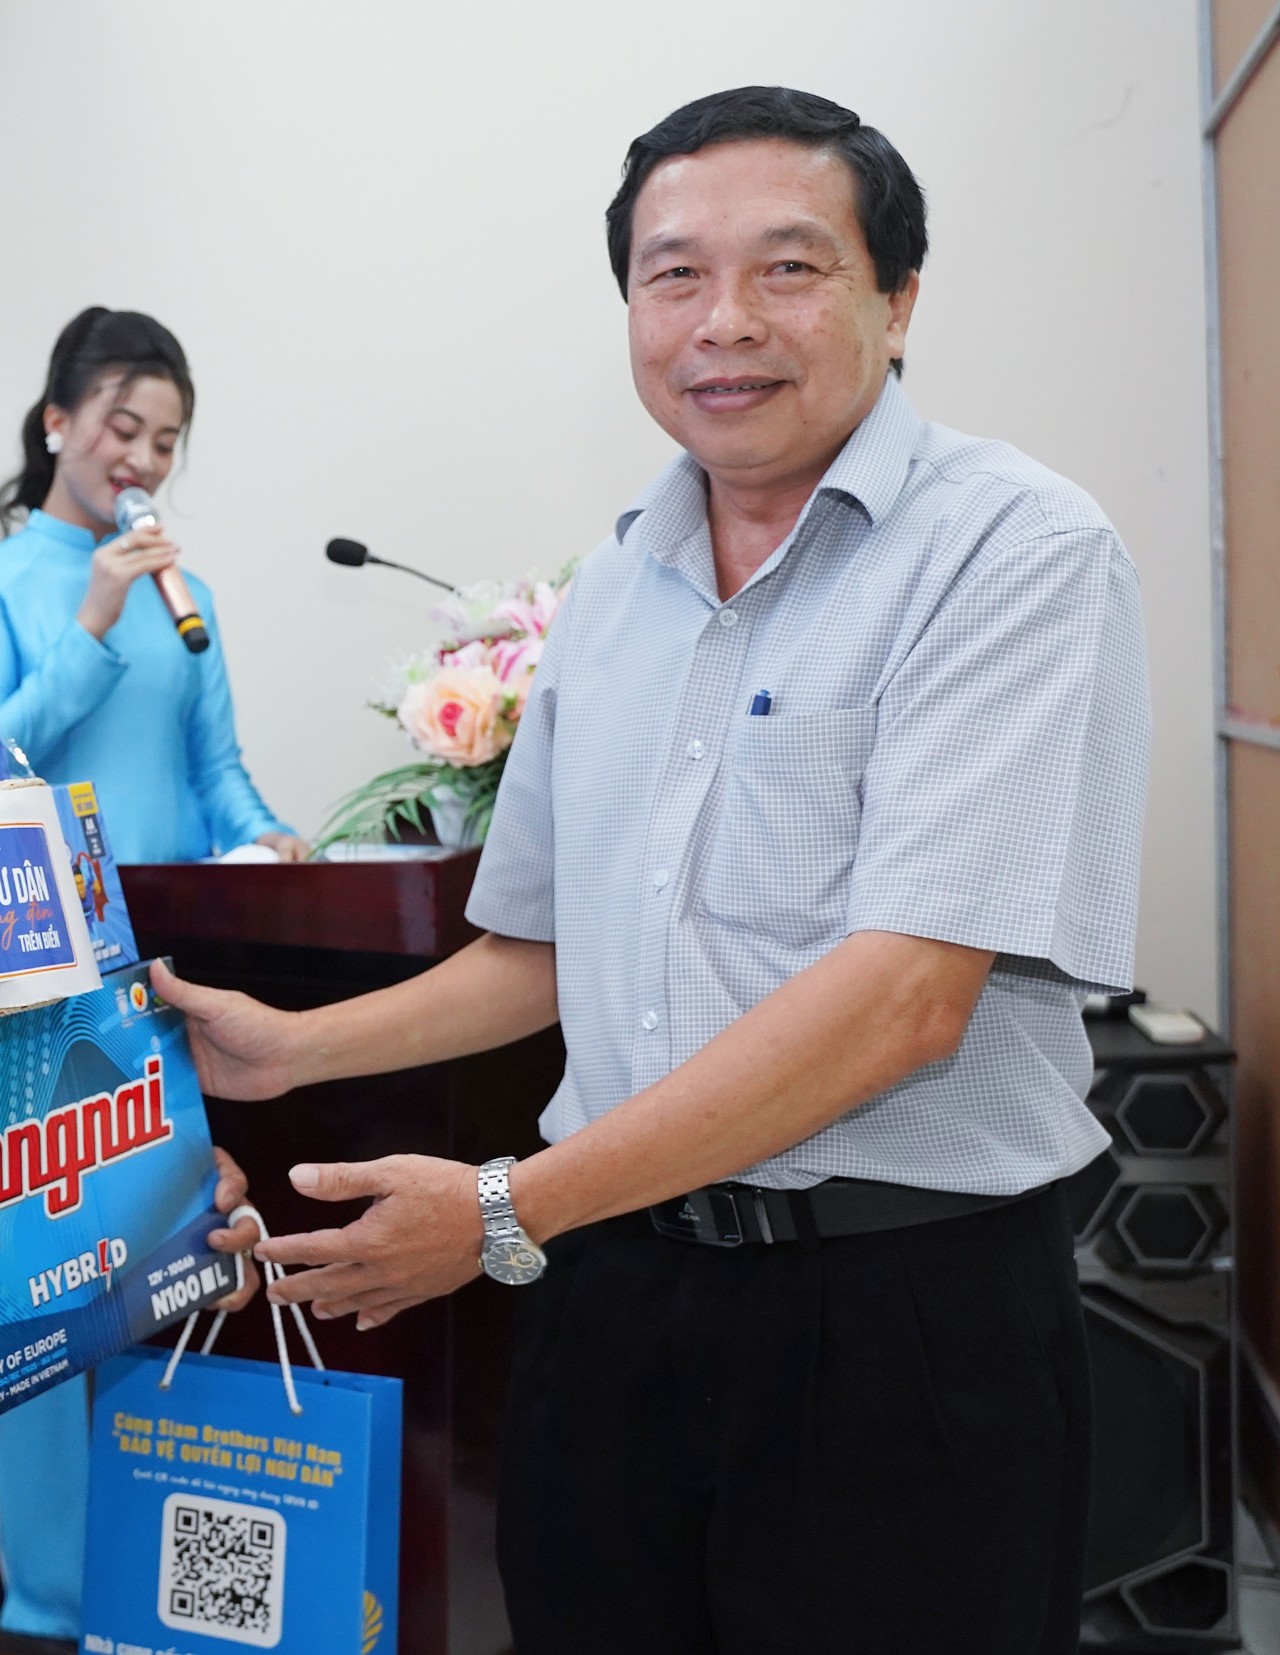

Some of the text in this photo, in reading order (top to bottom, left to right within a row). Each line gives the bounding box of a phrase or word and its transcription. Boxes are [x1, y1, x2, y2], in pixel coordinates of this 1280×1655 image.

[12, 859, 50, 904] DÂN
[18, 924, 61, 952] TRÊN BIỂN
[147, 1268, 163, 1287] 12V
[167, 1254, 196, 1277] 100Ah
[151, 1273, 201, 1321] N100
[6, 1350, 22, 1370] OF
[24, 1328, 68, 1361] EUROPE
[10, 1379, 31, 1396] MADE
[31, 1374, 40, 1385] IN
[40, 1359, 70, 1381] VIETNAM
[158, 1418, 198, 1440] Siam
[306, 1443, 342, 1466] Nam
